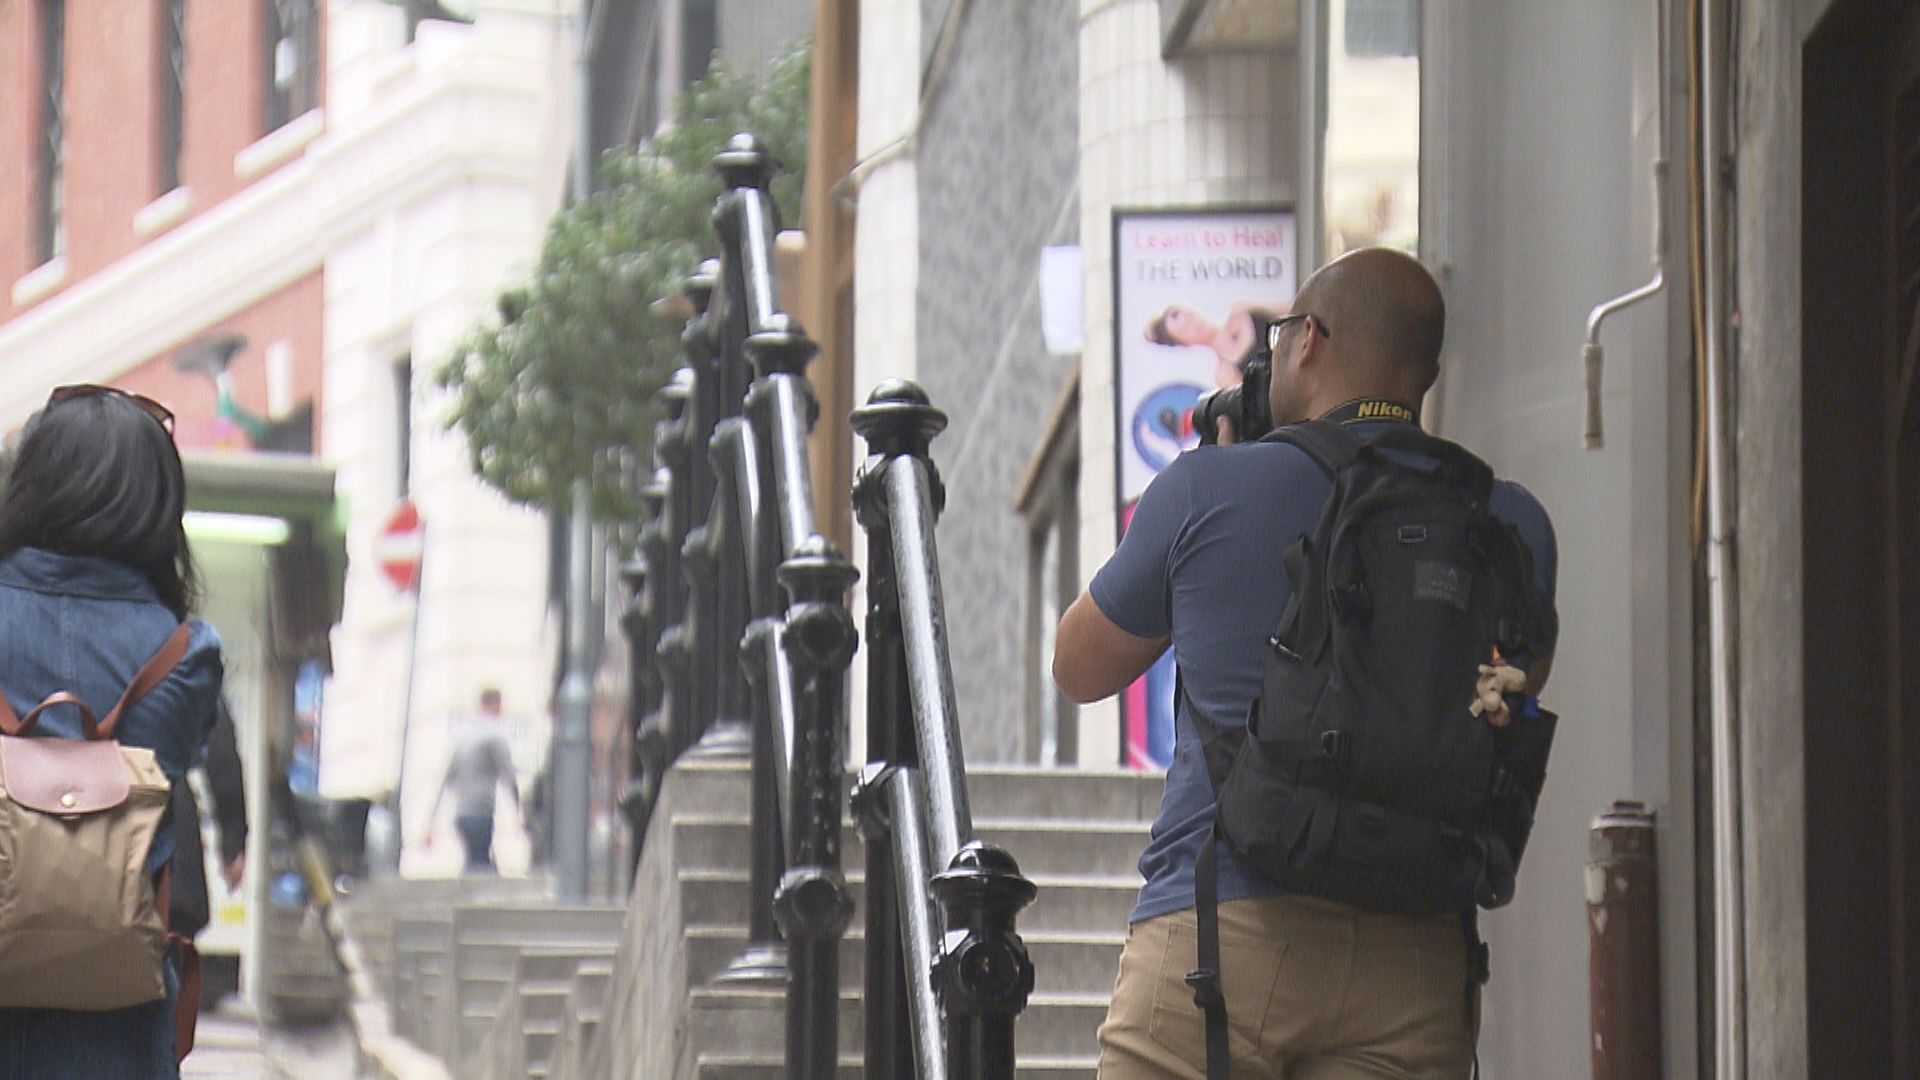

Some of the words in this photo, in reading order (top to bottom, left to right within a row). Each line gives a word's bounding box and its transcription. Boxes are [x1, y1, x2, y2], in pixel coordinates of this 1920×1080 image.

[1135, 228, 1196, 249] Learn
[1203, 229, 1225, 248] to
[1232, 224, 1284, 248] Heal
[1136, 258, 1182, 281] THE
[1191, 255, 1284, 280] WORLD
[1357, 401, 1412, 421] Nikon
